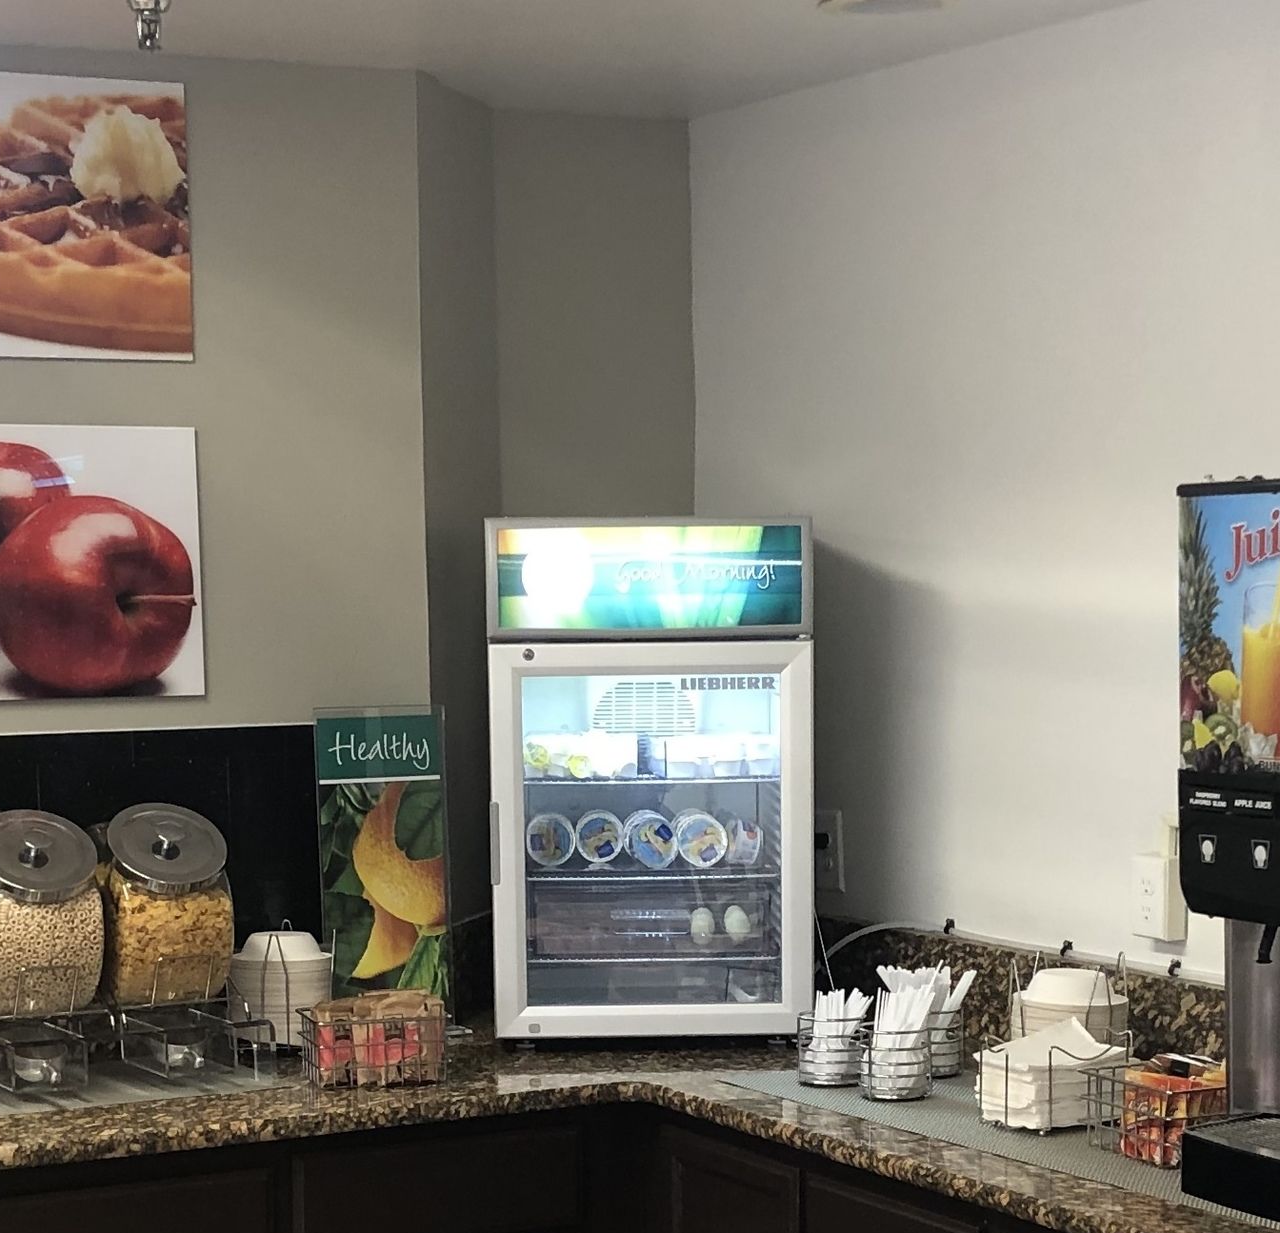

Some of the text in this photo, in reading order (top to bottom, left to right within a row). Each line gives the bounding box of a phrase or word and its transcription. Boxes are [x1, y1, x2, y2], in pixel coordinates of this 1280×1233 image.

[680, 676, 776, 691] LIEBHERR
[327, 731, 430, 770] Healthy
[1234, 799, 1272, 810] APPLE JUICE
